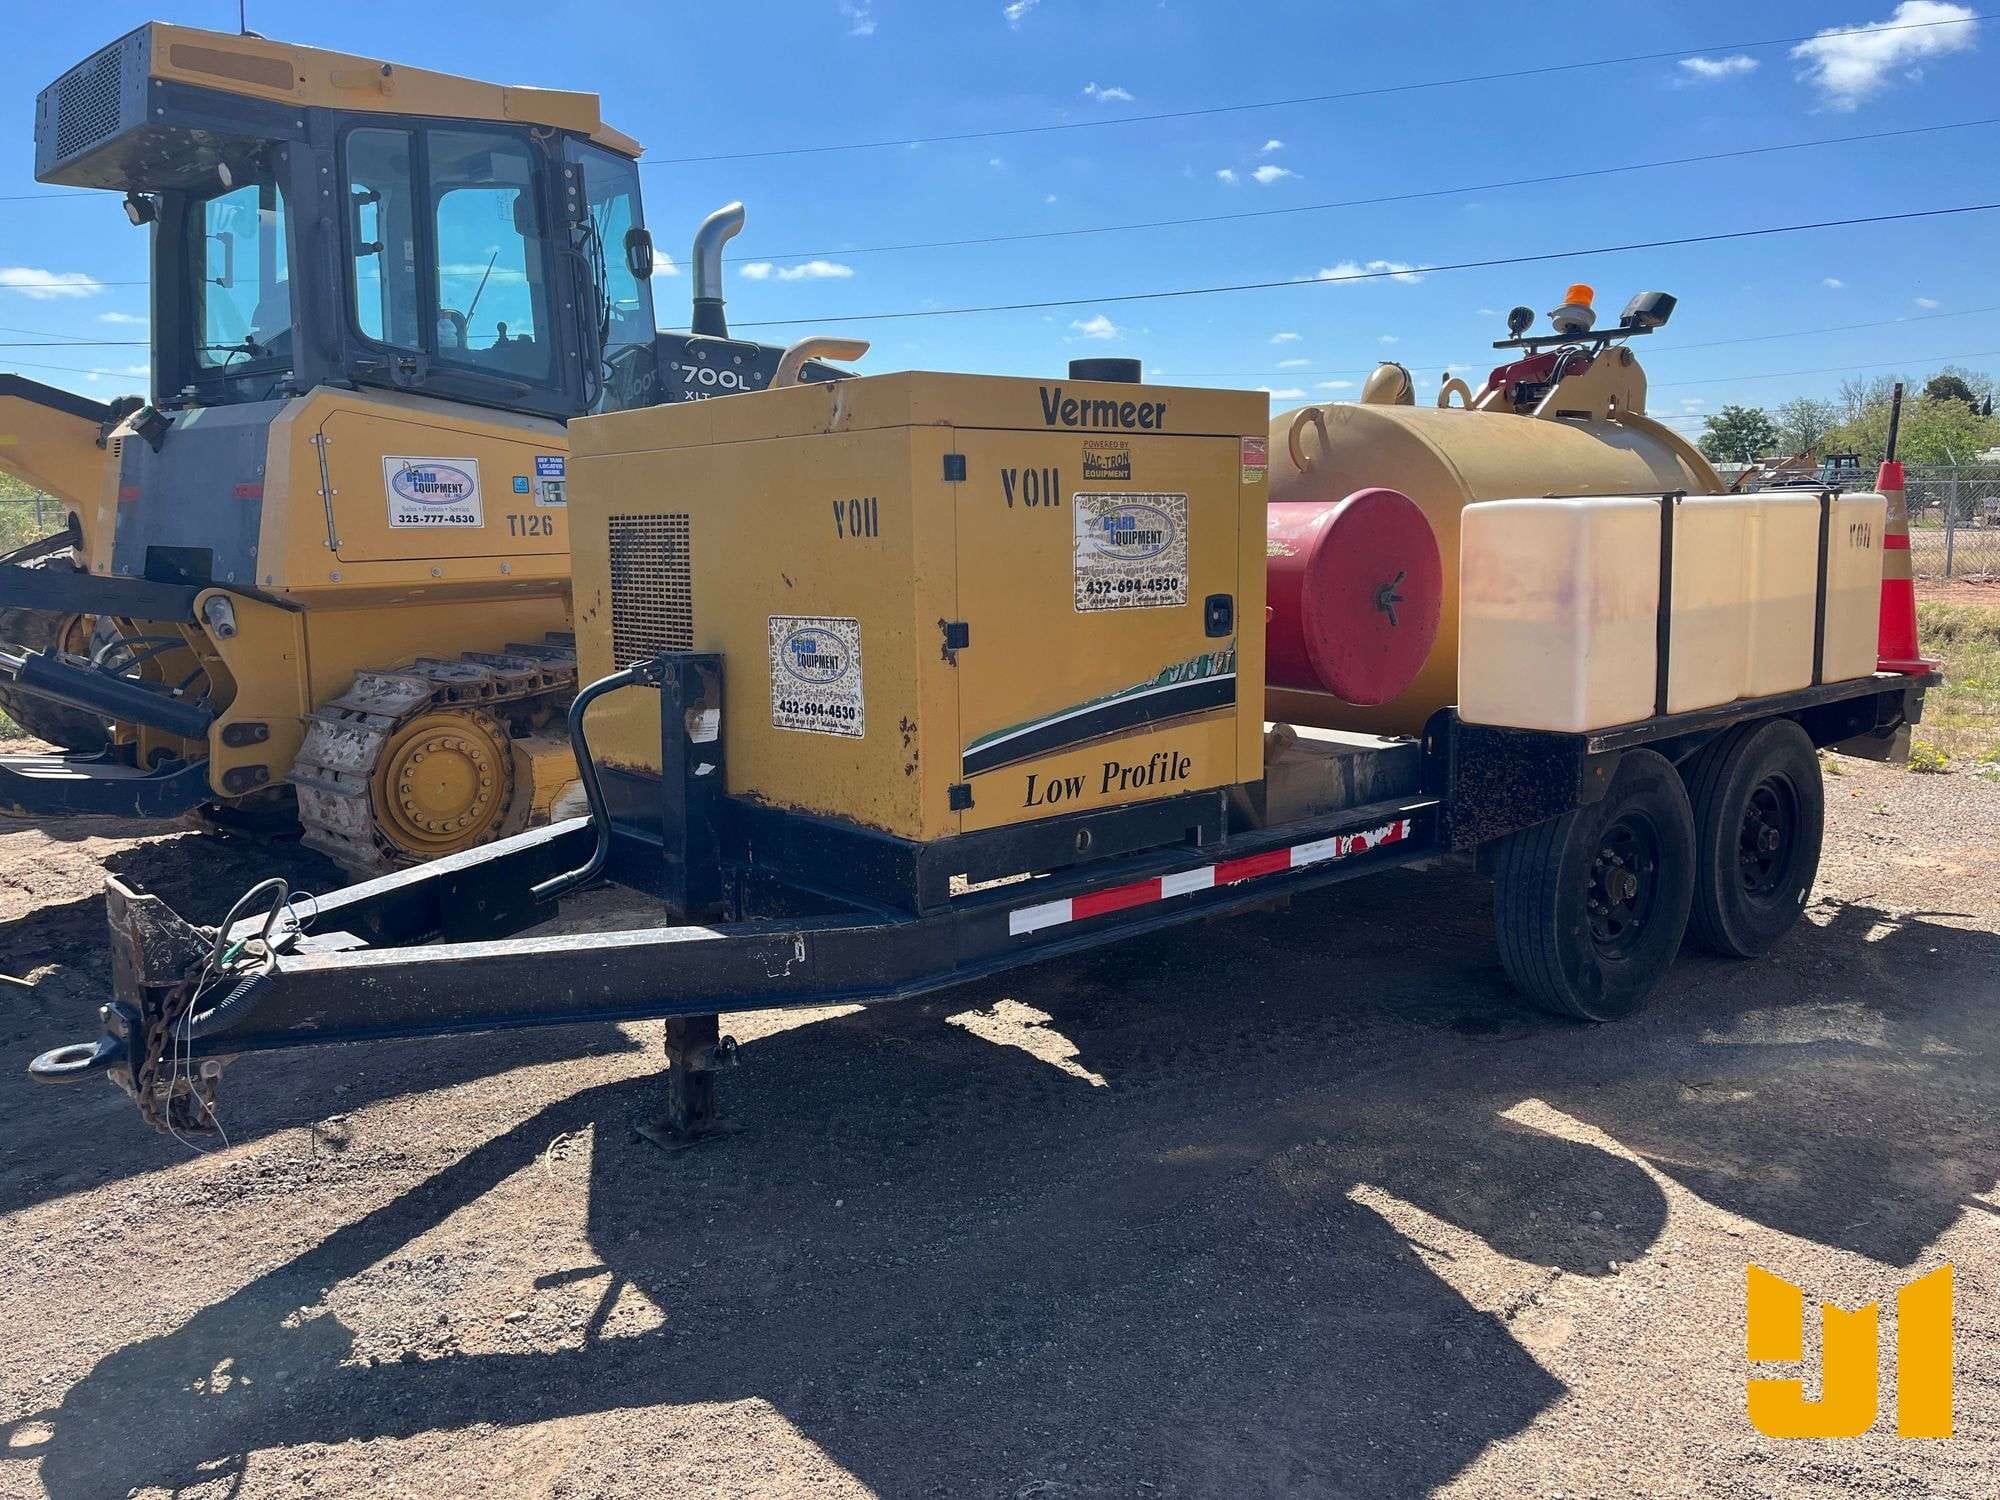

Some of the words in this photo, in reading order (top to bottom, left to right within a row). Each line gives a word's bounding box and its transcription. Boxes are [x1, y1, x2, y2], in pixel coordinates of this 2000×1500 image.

[681, 364, 751, 391] 700L
[1039, 386, 1167, 430] Vermeer
[1084, 469, 1129, 478] EQUIPMENT
[413, 482, 463, 494] EQUIPMENT
[398, 514, 475, 523] 325-777-4530
[506, 515, 553, 536] T126
[1110, 529, 1163, 546] EQUIPMENT
[1086, 577, 1179, 595] 432-694-4530
[797, 653, 839, 670] EQUIPMENT
[779, 699, 856, 720] 432-694-4530
[1022, 774, 1087, 808] Low
[1099, 751, 1192, 795] Profile
